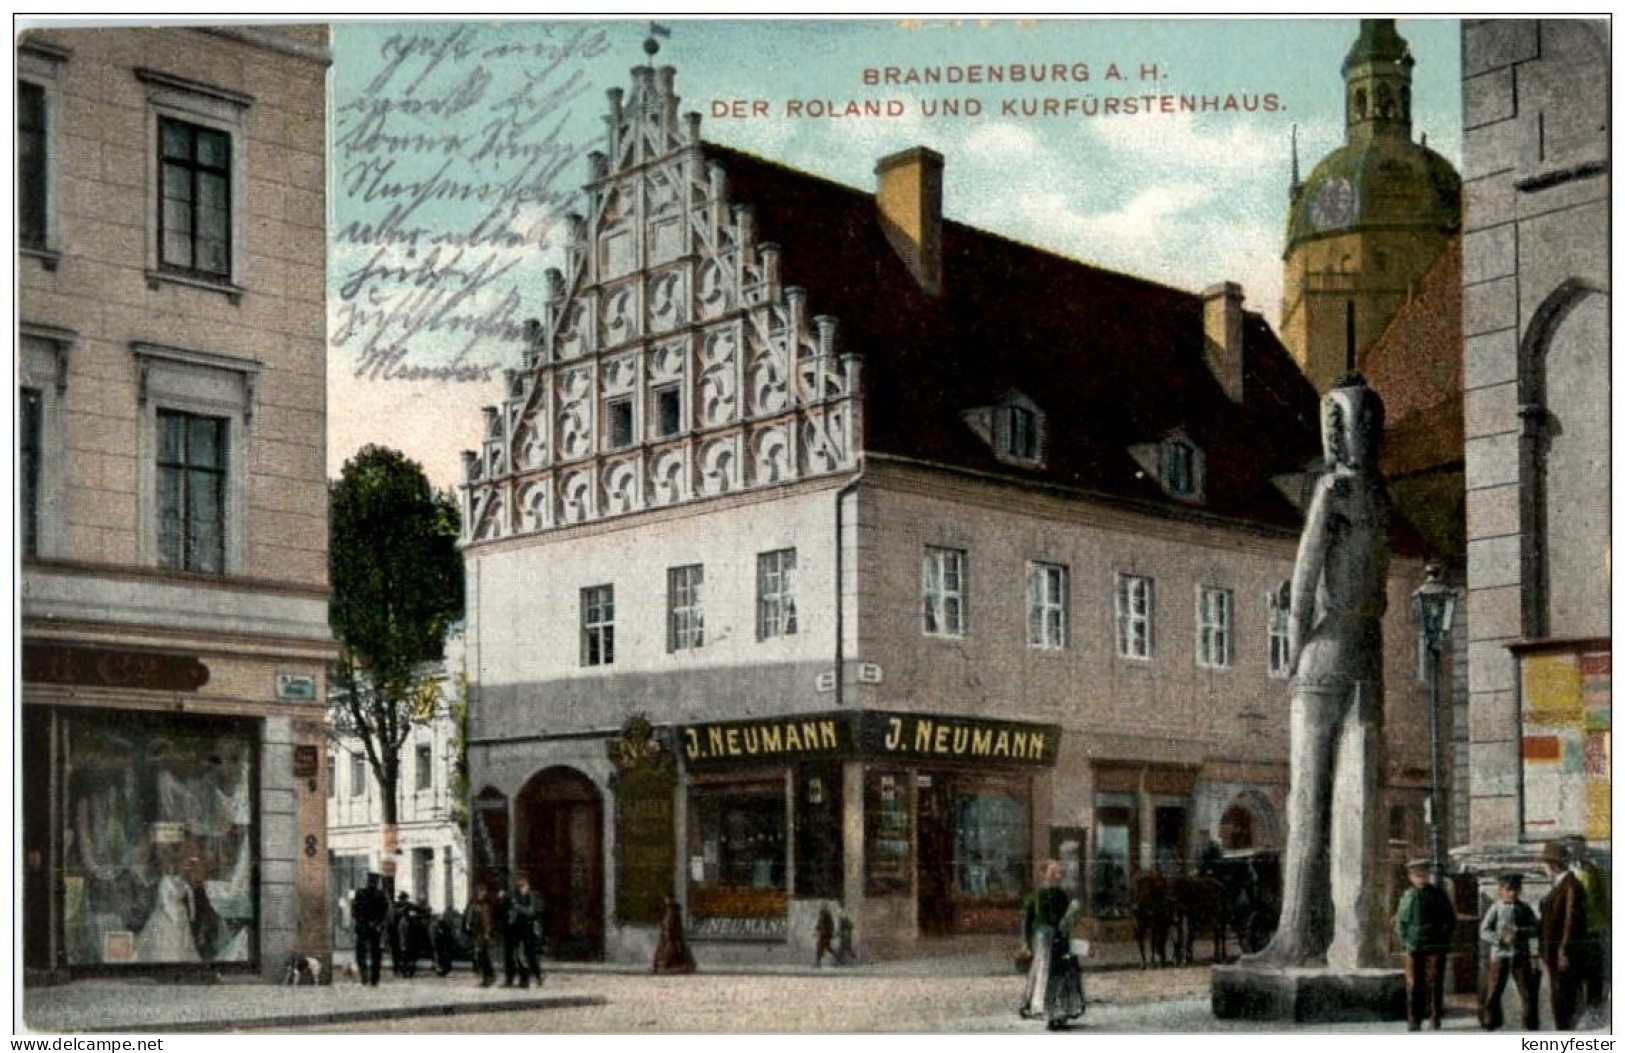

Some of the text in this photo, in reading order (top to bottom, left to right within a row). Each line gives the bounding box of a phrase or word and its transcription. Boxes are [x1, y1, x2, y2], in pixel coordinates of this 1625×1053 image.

[708, 720, 837, 757] NEUMANN
[885, 716, 1045, 760] J. NEUMANN
